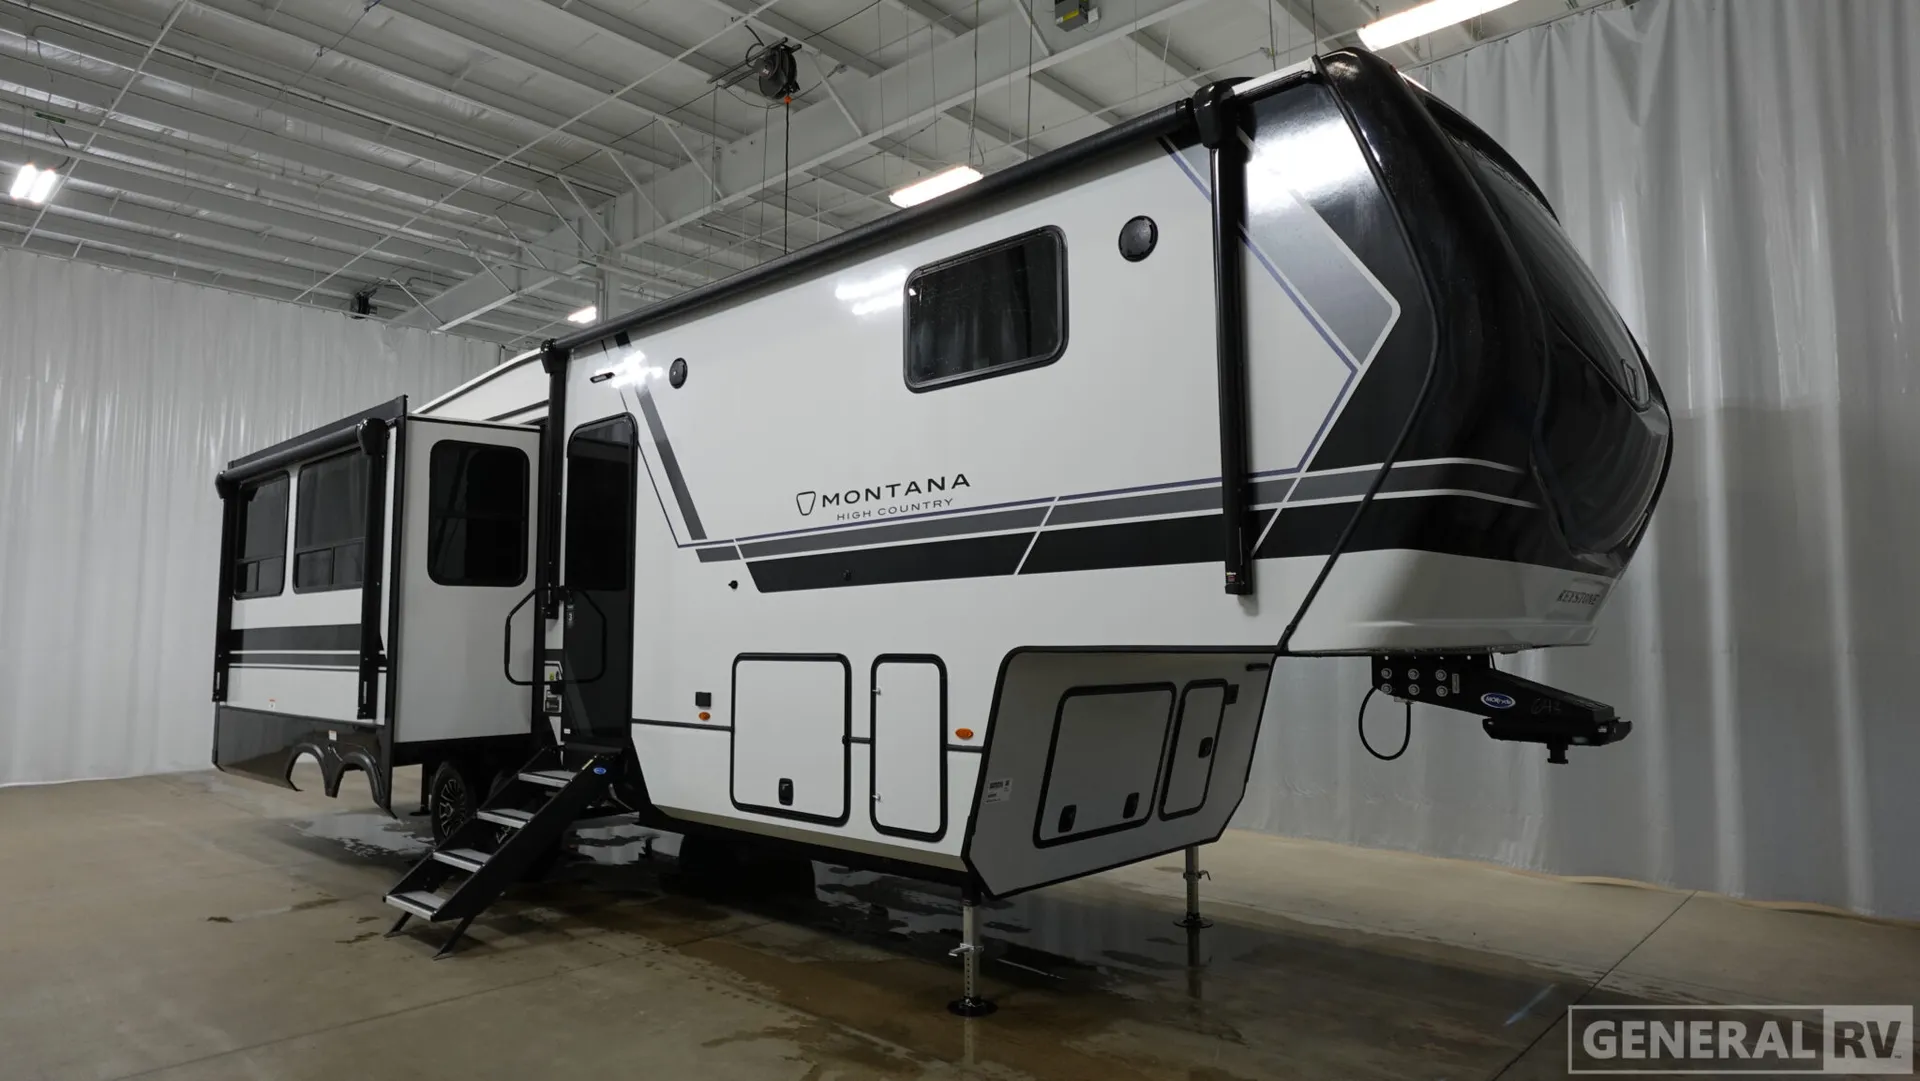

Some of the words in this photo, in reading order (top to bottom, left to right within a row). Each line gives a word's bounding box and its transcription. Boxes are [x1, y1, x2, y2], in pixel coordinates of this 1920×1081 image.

[822, 473, 970, 508] MONTANA
[837, 510, 871, 521] HIGH
[878, 498, 953, 516] COUNTRY
